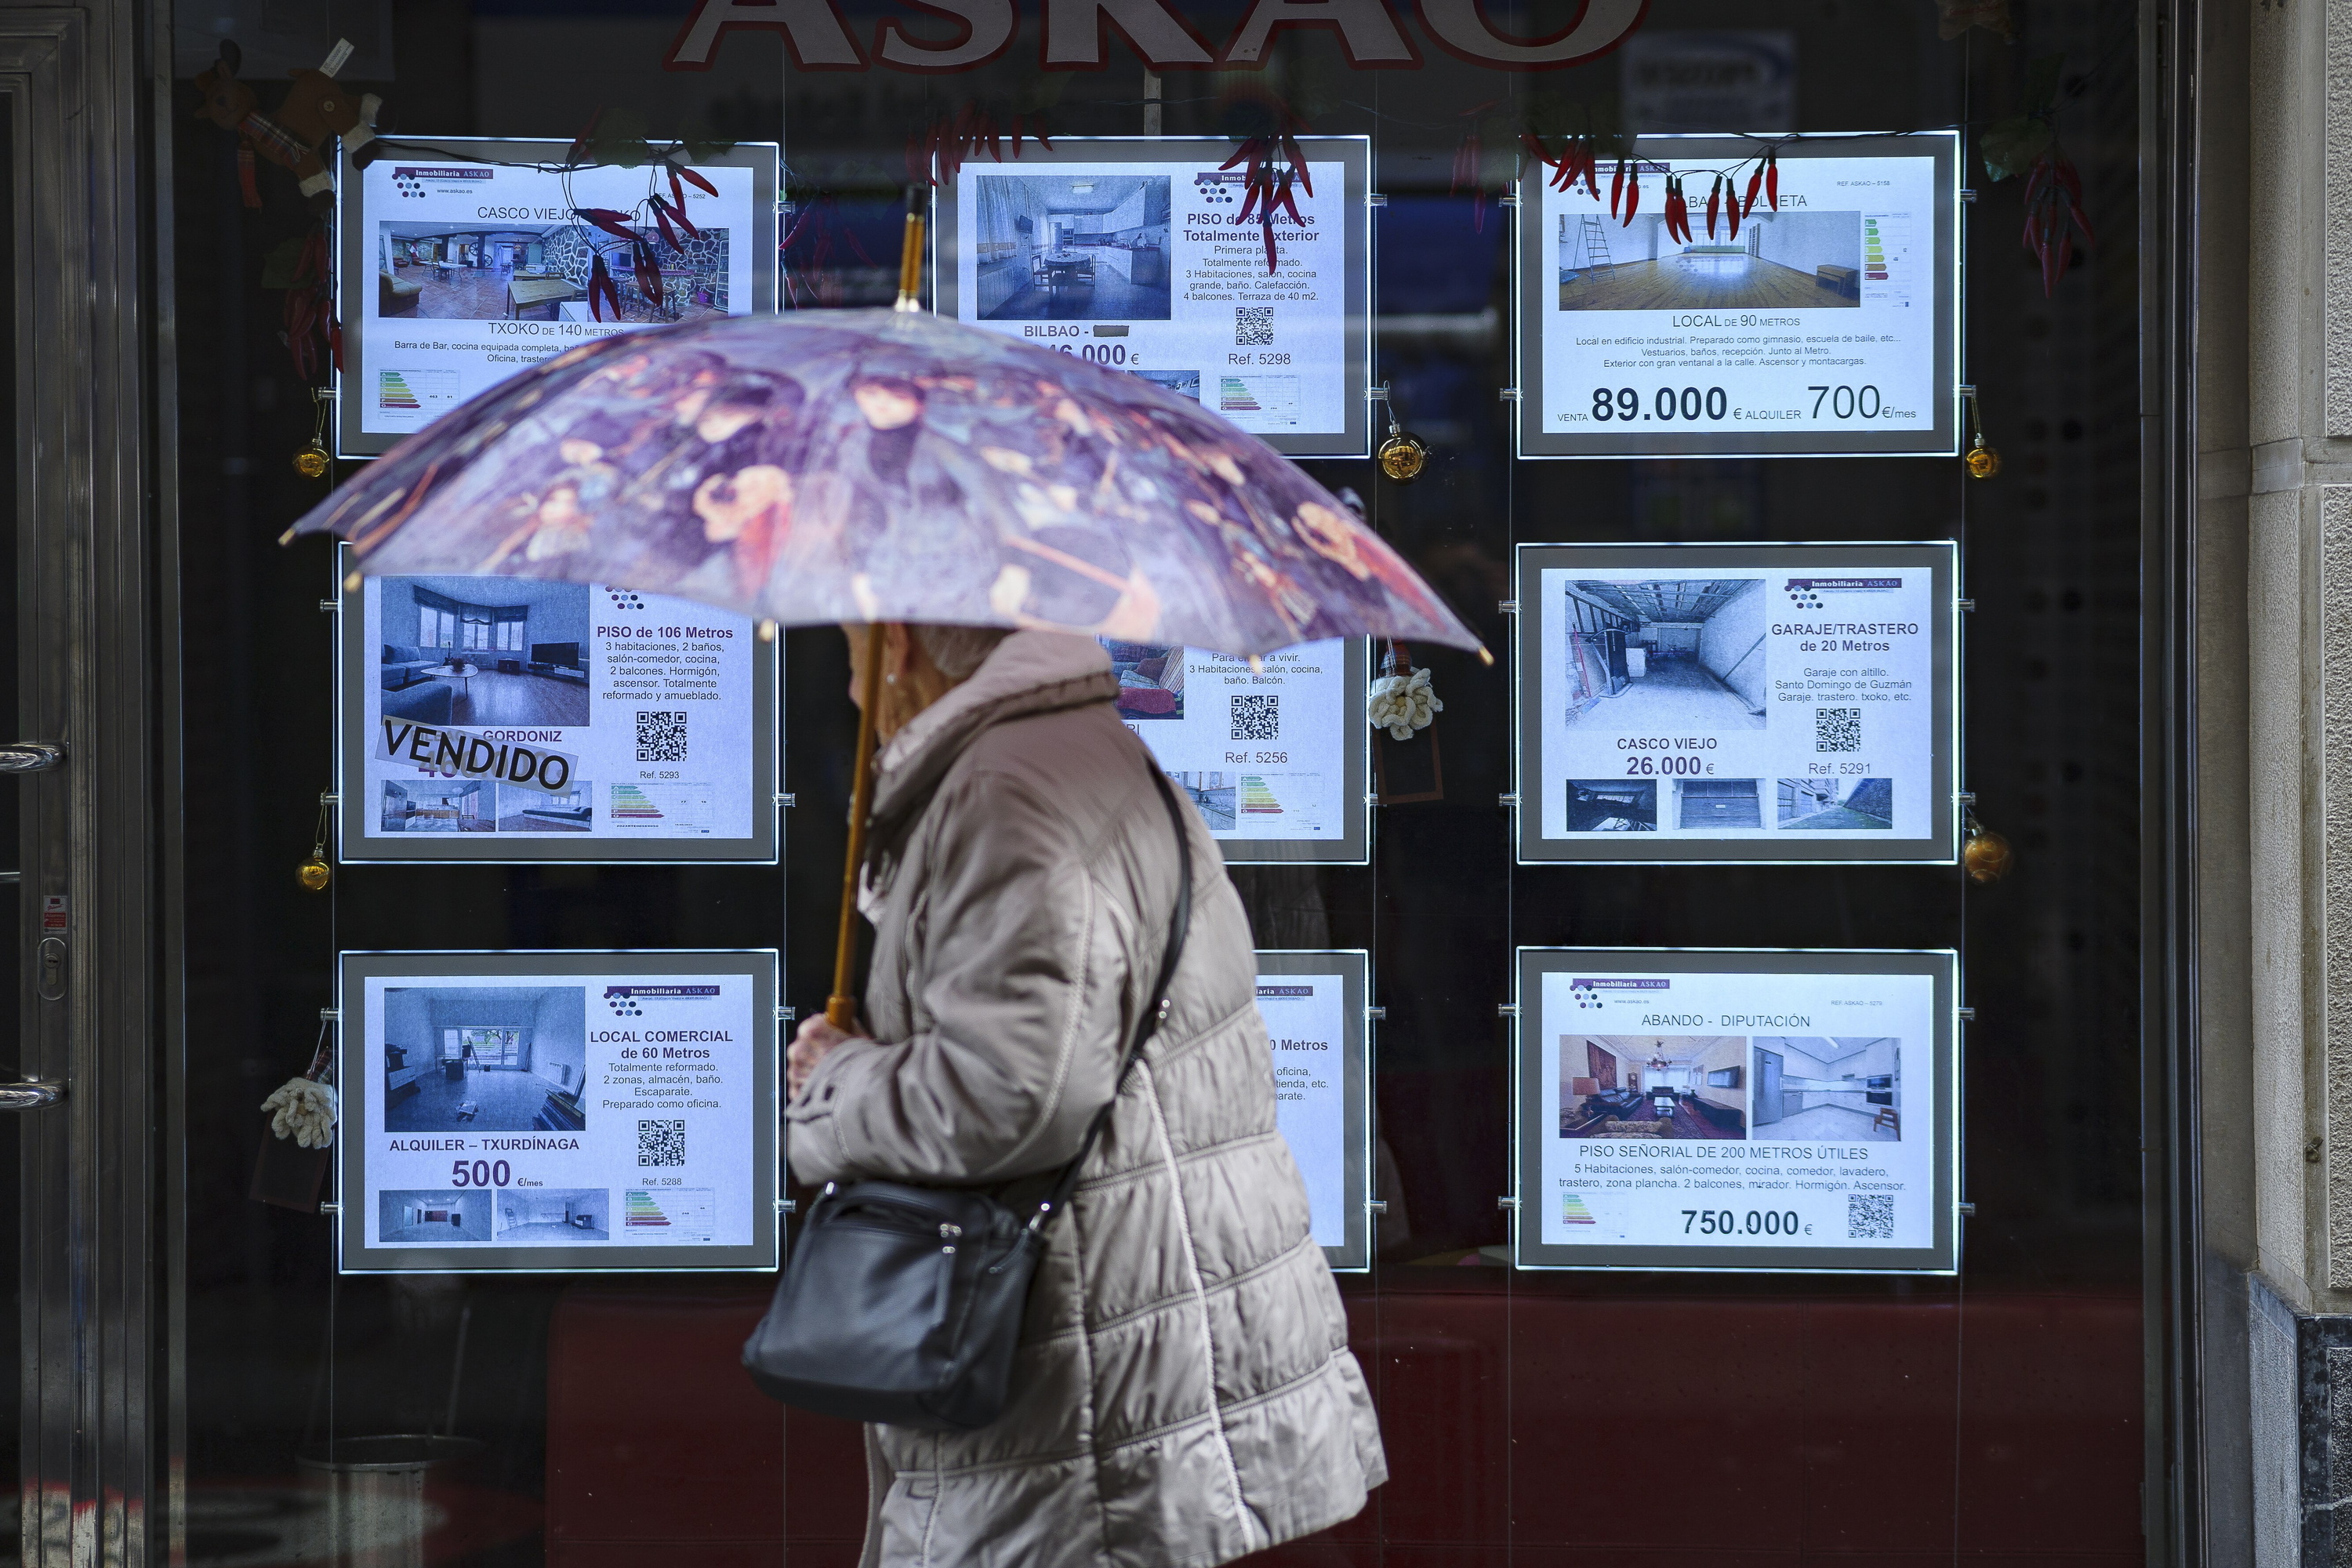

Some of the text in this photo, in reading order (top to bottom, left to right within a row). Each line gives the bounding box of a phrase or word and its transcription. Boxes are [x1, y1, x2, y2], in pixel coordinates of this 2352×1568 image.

[477, 206, 529, 219] CASCO
[534, 208, 576, 220] VIEJO
[1187, 212, 1221, 225] PISO
[1182, 230, 1259, 241] Totalmente
[1189, 280, 1309, 292] grande, baño. Calefacción.
[1183, 292, 1319, 301] 4 balcones. Terraza de 40 m2.
[1672, 314, 1722, 327] LOCAL
[1740, 314, 1756, 326] 90
[1759, 318, 1800, 326] METROS
[488, 321, 624, 337] TXOKO DE 140 METROS
[1024, 325, 1080, 337] BILBAO
[1576, 336, 1599, 346] Local
[1614, 336, 1644, 345] edificio
[1646, 336, 1686, 345] industrial.
[1690, 335, 1734, 346] Preparado
[1762, 335, 1802, 345] gimnasio,
[1806, 334, 1838, 343] escuela
[1841, 334, 1853, 343] de
[1854, 334, 1877, 343] baile,
[395, 341, 562, 354] Barra de Bar, cocina equipada completa,
[487, 354, 518, 363] Oficina,
[1229, 353, 1290, 365] Ref. 5298
[1592, 386, 1741, 421] 89.000 €
[1807, 385, 1916, 419] 700 €/mes
[1557, 413, 1588, 422] VENTA
[1744, 409, 1801, 419] ALQUILER
[597, 626, 733, 638] PISO de 106 Metros
[1771, 622, 1918, 635] GARAJE/TRASTERO
[605, 641, 724, 652] 3 habitaciones, 2 baños,
[1799, 640, 1889, 652] de 20 Metros
[607, 653, 720, 665] salón-comedor, cocina,
[610, 666, 720, 677] 2 balcones. Hormigón,
[1803, 667, 1837, 679] Garaje
[1860, 667, 1889, 677] altillo.
[662, 678, 717, 688] Totalmente
[1224, 676, 1285, 684] baño. Balcón.
[1774, 679, 1911, 691] Santo Domingo de Guzmán
[602, 690, 720, 702] reformado y amueblado.
[483, 730, 562, 742] GORDONIZ
[1617, 738, 1717, 750] CASCO VIEJO
[384, 719, 570, 790] VENDIDO
[1225, 751, 1287, 764] Ref. 5256
[1626, 756, 1714, 775] 26.000 €
[1809, 762, 1870, 775] Ref. 5291
[1641, 1013, 1809, 1027] ABANDO DIPUTACIÓN
[590, 1030, 733, 1043] LOCAL COMERCIAL
[1281, 1039, 1328, 1051] Metros
[621, 1047, 710, 1058] de 60 Metros
[608, 1062, 718, 1072] Totalmente reformado.
[1276, 1067, 1311, 1076] oficina,
[603, 1074, 723, 1086] 2 zonas, almacén, baño.
[1312, 1080, 1329, 1088] etc.
[634, 1087, 692, 1098] Escaparate.
[602, 1099, 654, 1110] Preparado
[686, 1098, 721, 1108] oficina.
[389, 1135, 579, 1152] ALQUILER TXURDÍNAGA
[1580, 1144, 1867, 1160] PISO SEÑORIAL DE 200 METROS ÚTILES
[451, 1159, 510, 1188] 500
[517, 1177, 543, 1186] €/mes
[642, 1177, 682, 1185] Ref. 5288
[1559, 1178, 1905, 1192] trastero, zona plancha. 2 balcones, mirador. Hormigón. Ascensor.
[1681, 1210, 1812, 1235] 750.000 €
